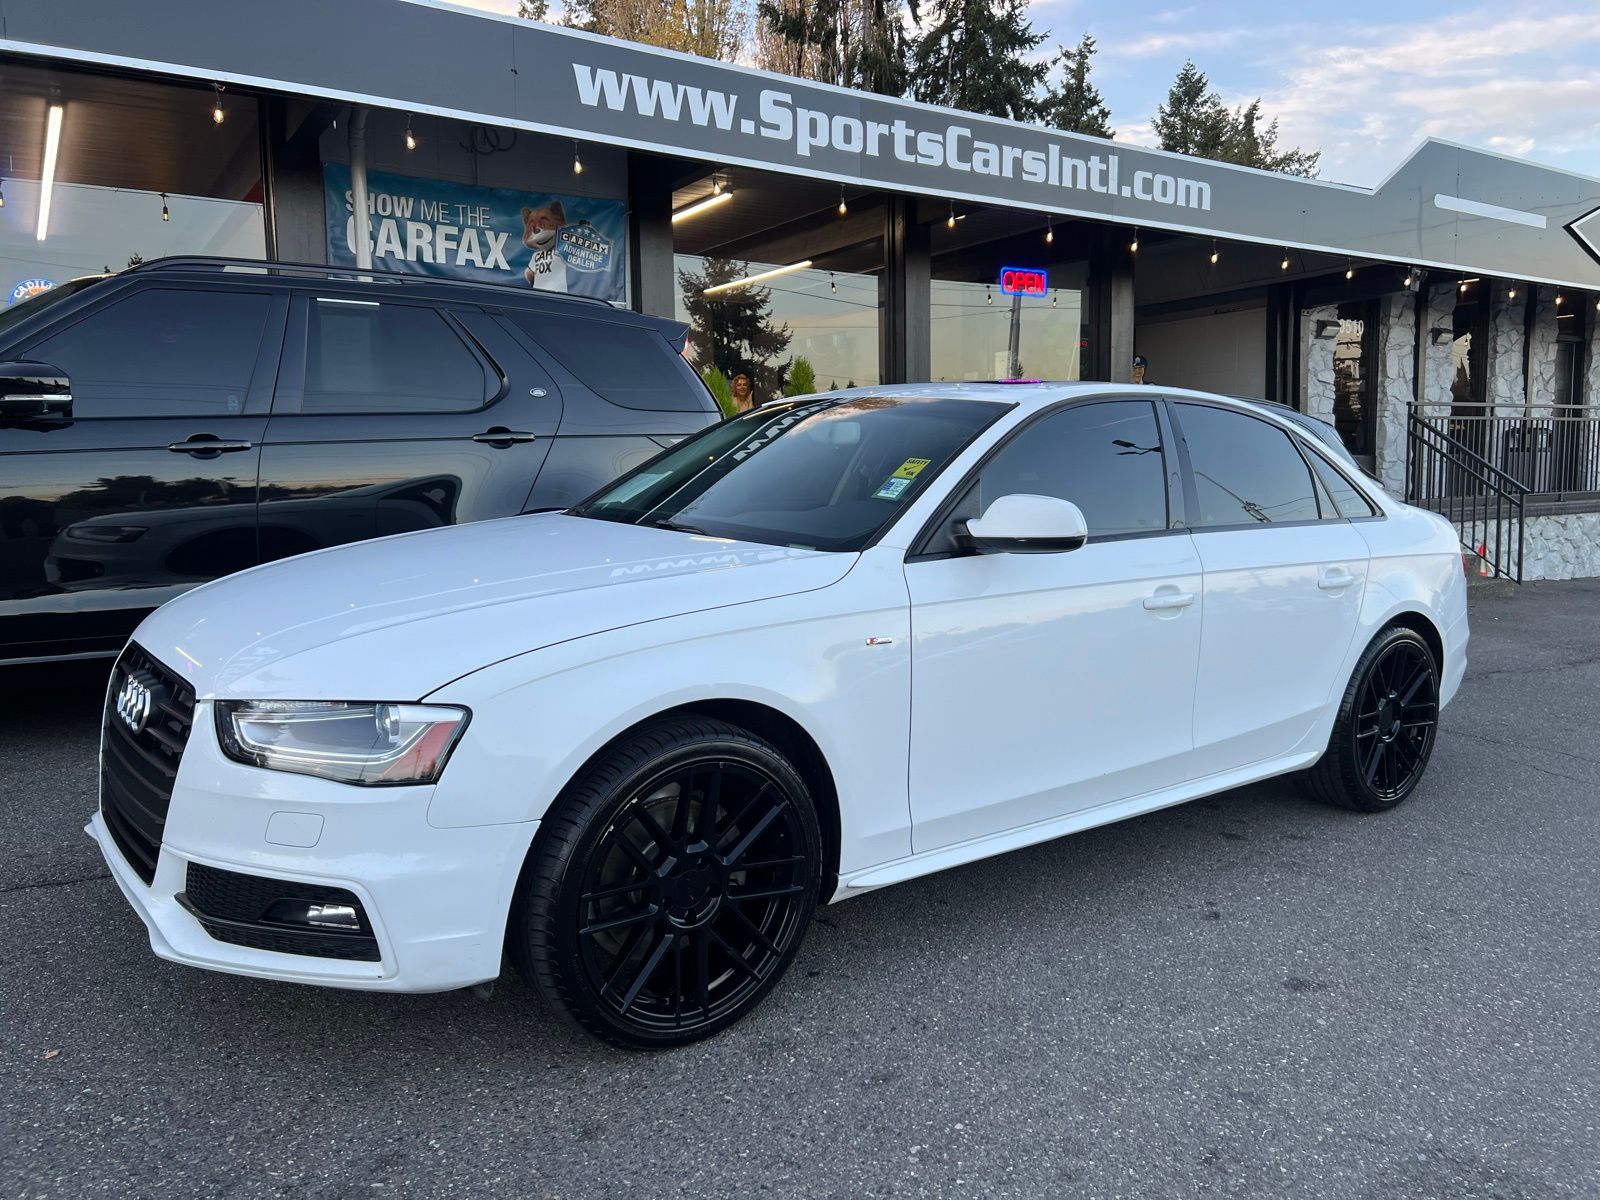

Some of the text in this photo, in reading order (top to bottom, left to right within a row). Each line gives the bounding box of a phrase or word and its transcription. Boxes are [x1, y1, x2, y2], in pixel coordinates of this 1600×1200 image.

[572, 63, 1211, 211] www.SportsCarsIntl.com
[420, 199, 450, 224] ME
[454, 204, 491, 229] THE
[346, 214, 511, 271] CARFAX
[562, 233, 608, 254] CARFAX
[534, 249, 553, 262] CAR
[563, 244, 604, 263] ADVANTAGE
[567, 254, 595, 269] DEALER
[535, 262, 552, 274] FOX
[1003, 271, 1045, 293] OPEN
